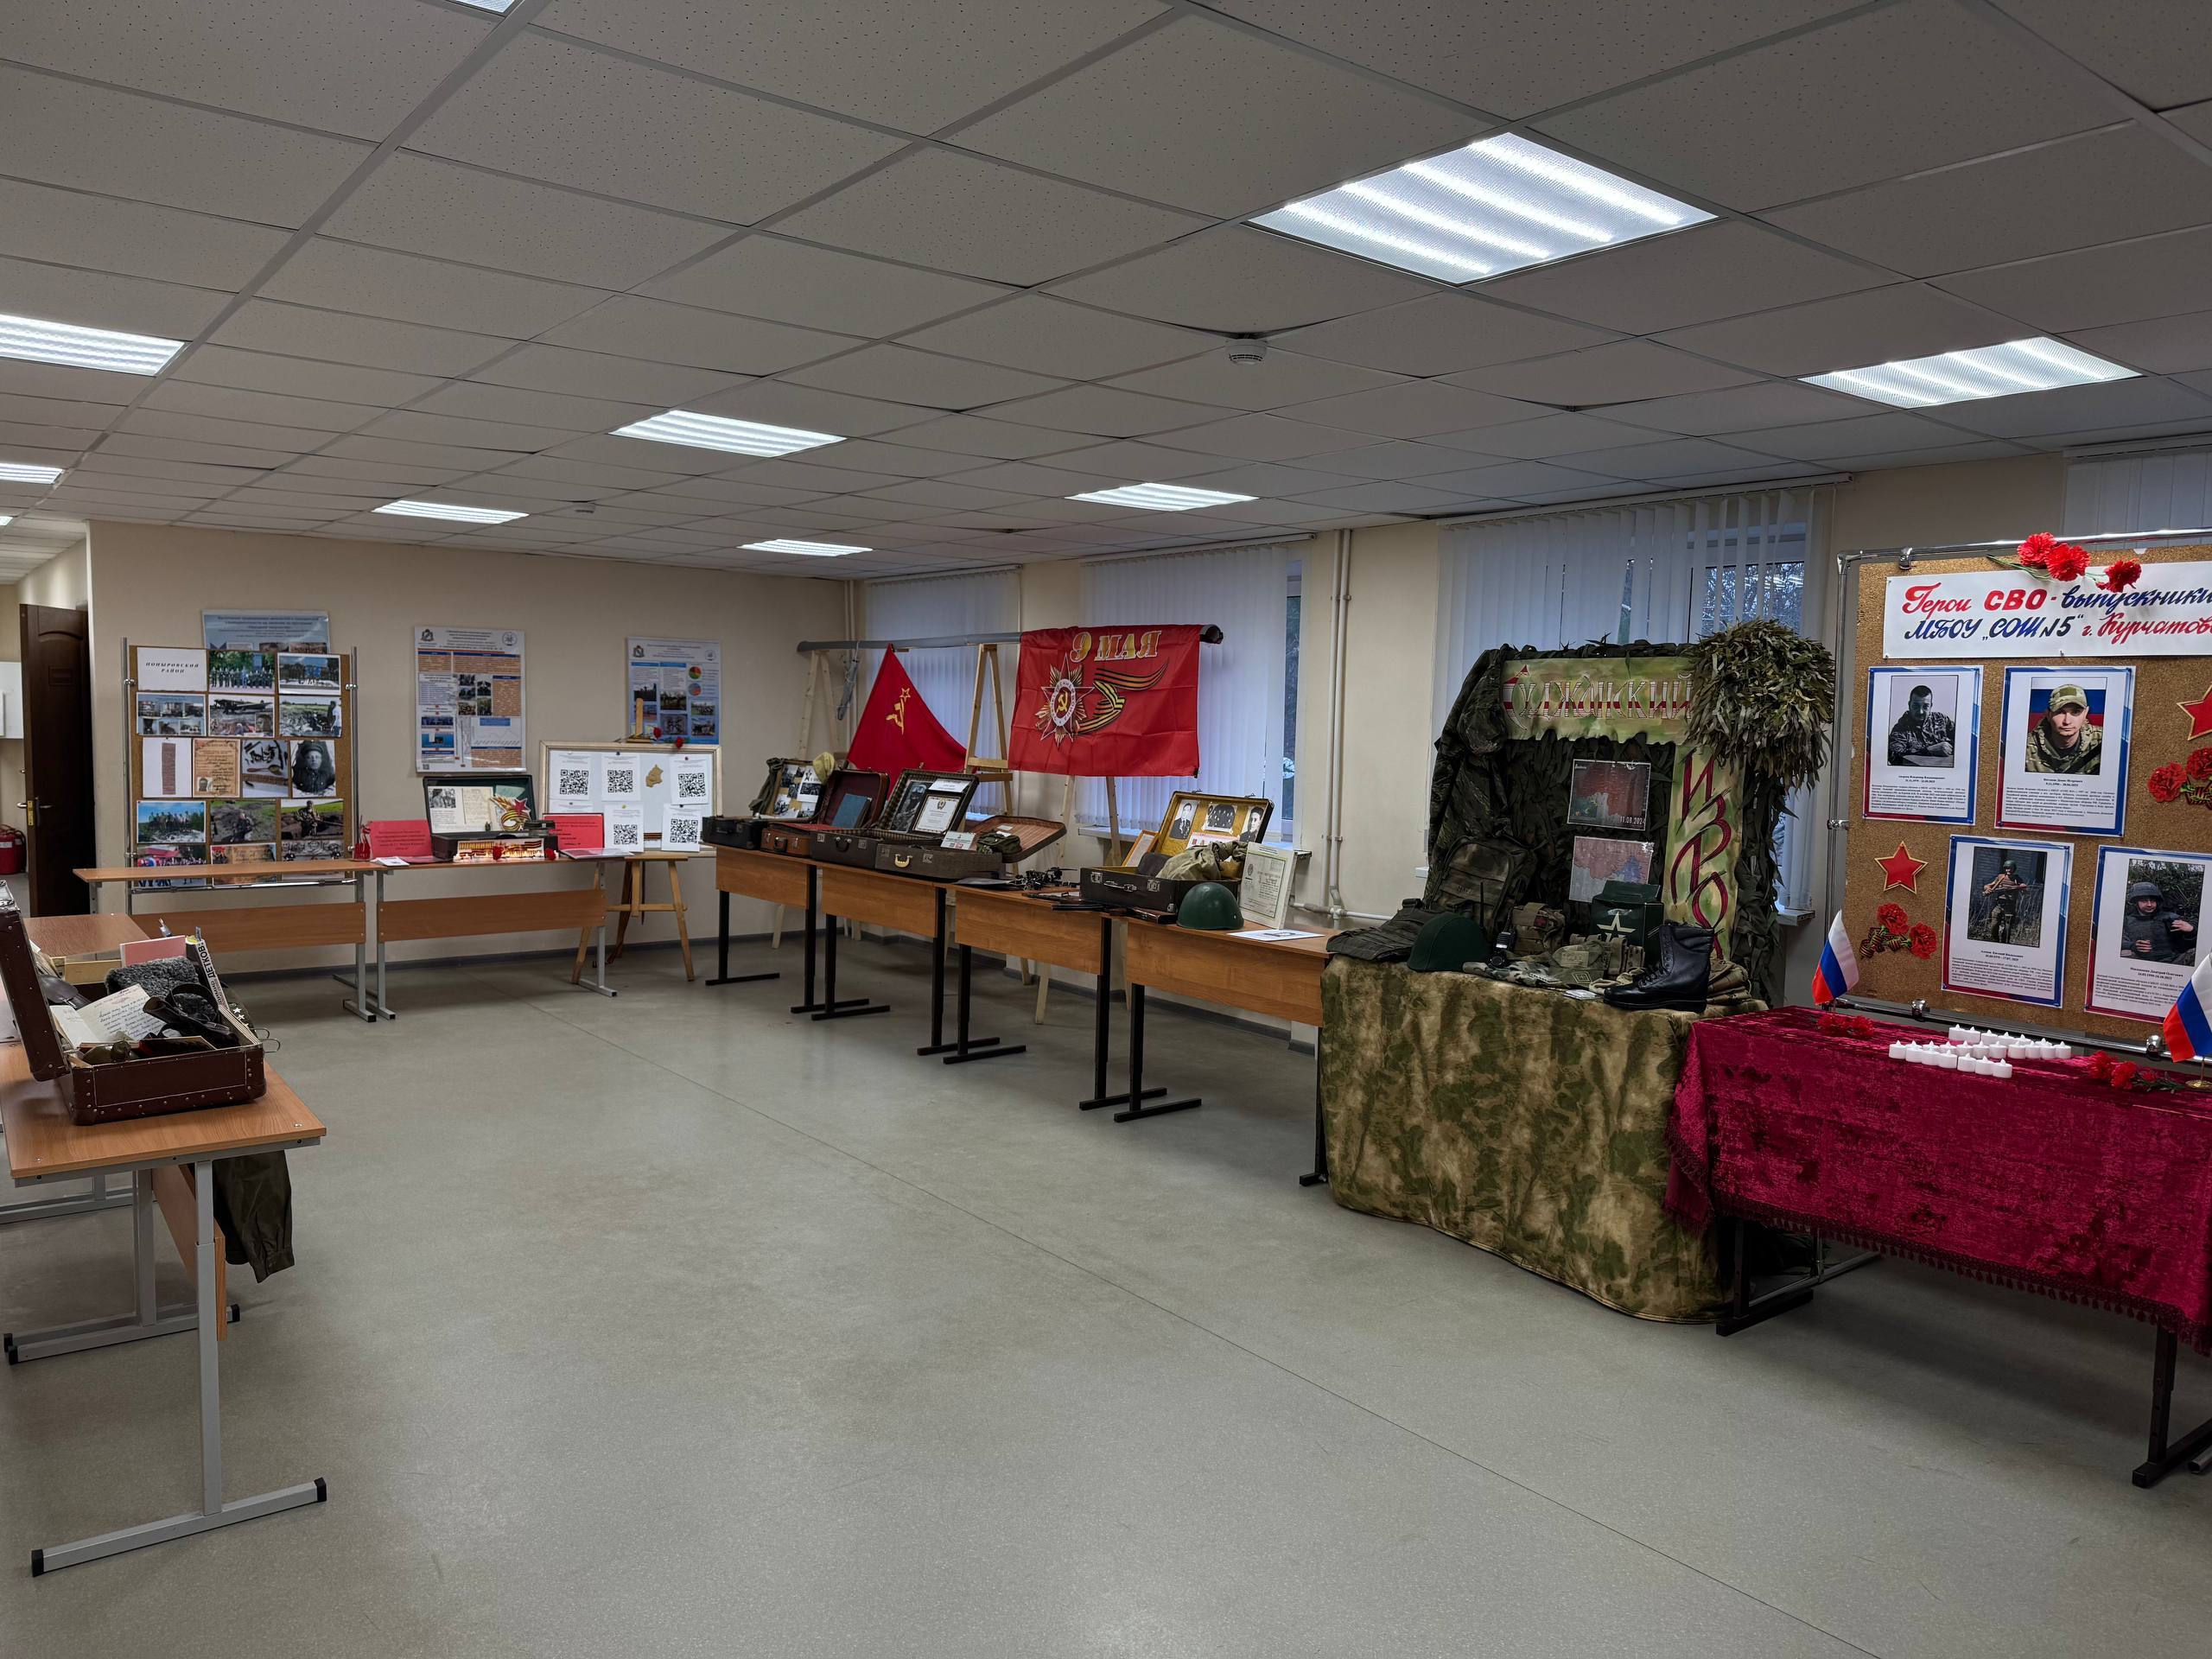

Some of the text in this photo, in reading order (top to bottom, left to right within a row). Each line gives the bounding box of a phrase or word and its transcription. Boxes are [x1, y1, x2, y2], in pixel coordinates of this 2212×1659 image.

[1902, 582, 1972, 620] Герои
[1983, 588, 2048, 611] СВО
[1904, 618, 1984, 640] МБОУ
[2082, 625, 2093, 637] г.
[2097, 612, 2212, 645] Курчатов
[1070, 631, 1162, 663] 9 МАЯ
